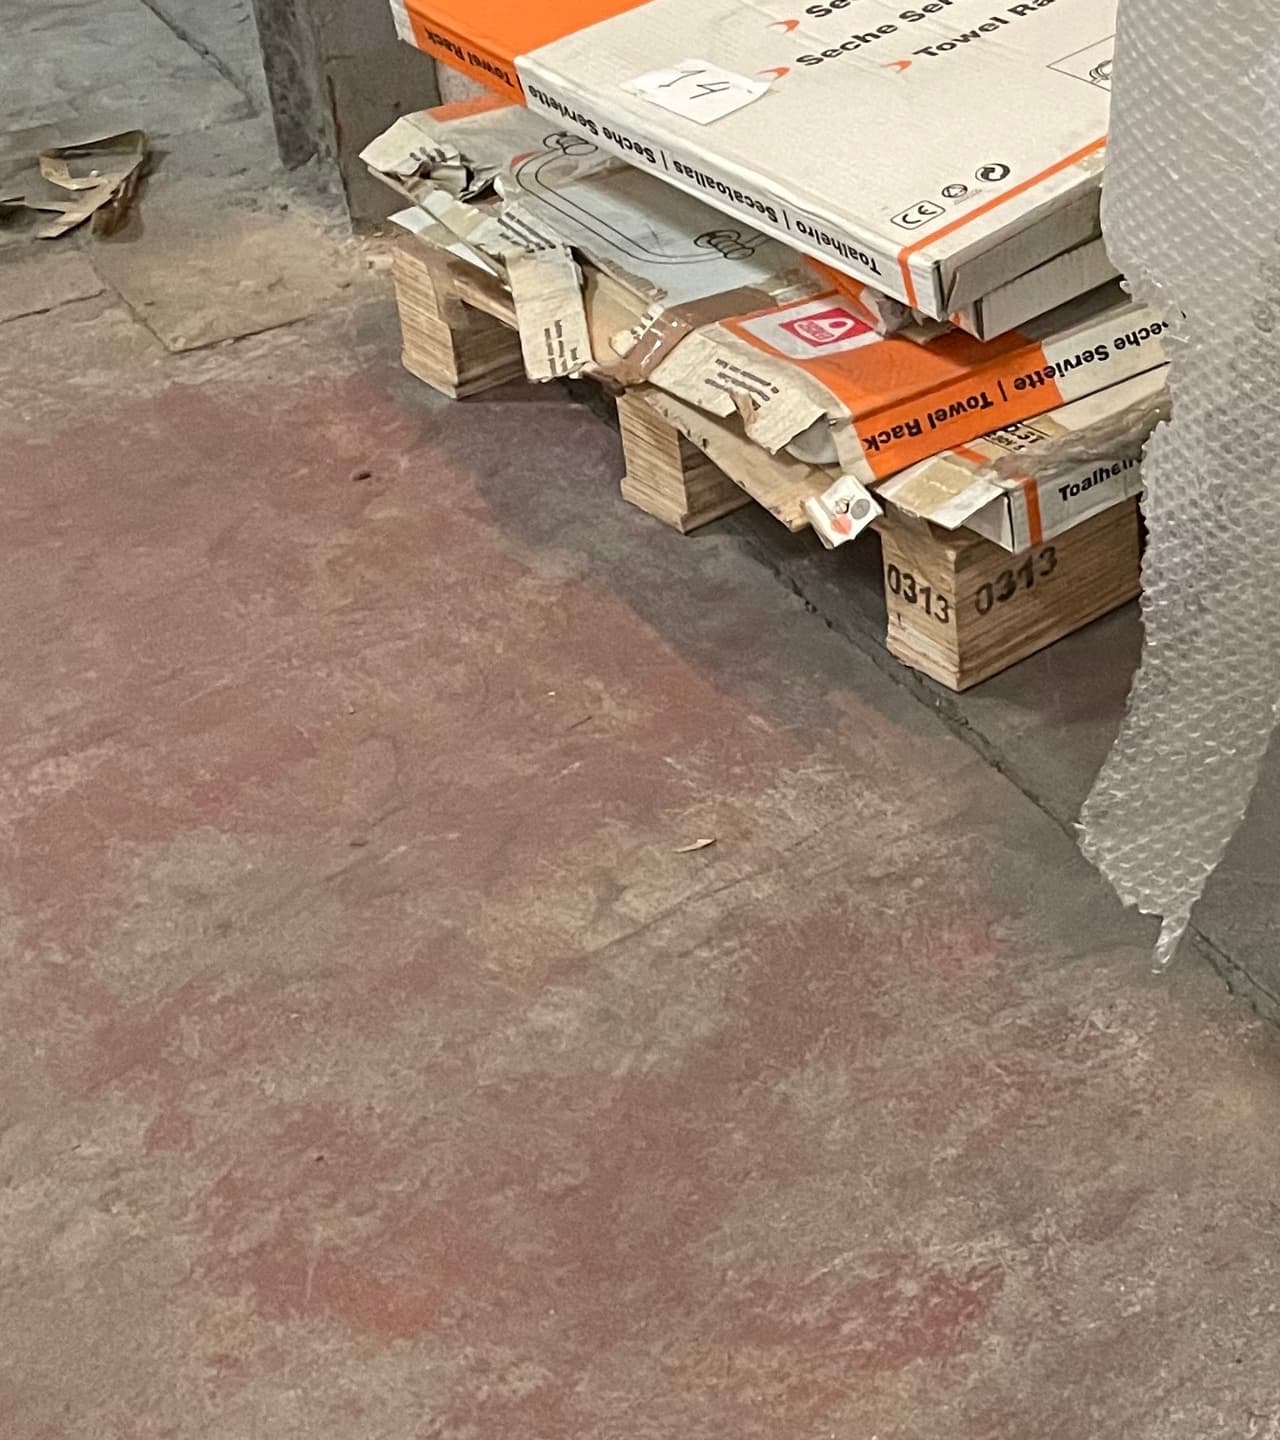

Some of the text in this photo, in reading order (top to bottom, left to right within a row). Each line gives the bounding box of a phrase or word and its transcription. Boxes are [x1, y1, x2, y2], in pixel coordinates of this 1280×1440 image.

[796, 24, 898, 66] Seche
[913, 16, 1009, 56] Towel
[658, 69, 731, 100] 14
[424, 27, 882, 277] Toalheiro Secatoallas Seche Serviette Towel Rack
[862, 319, 1169, 452] eche Serviette Towel Rack
[887, 546, 1058, 624] 0313 0313
